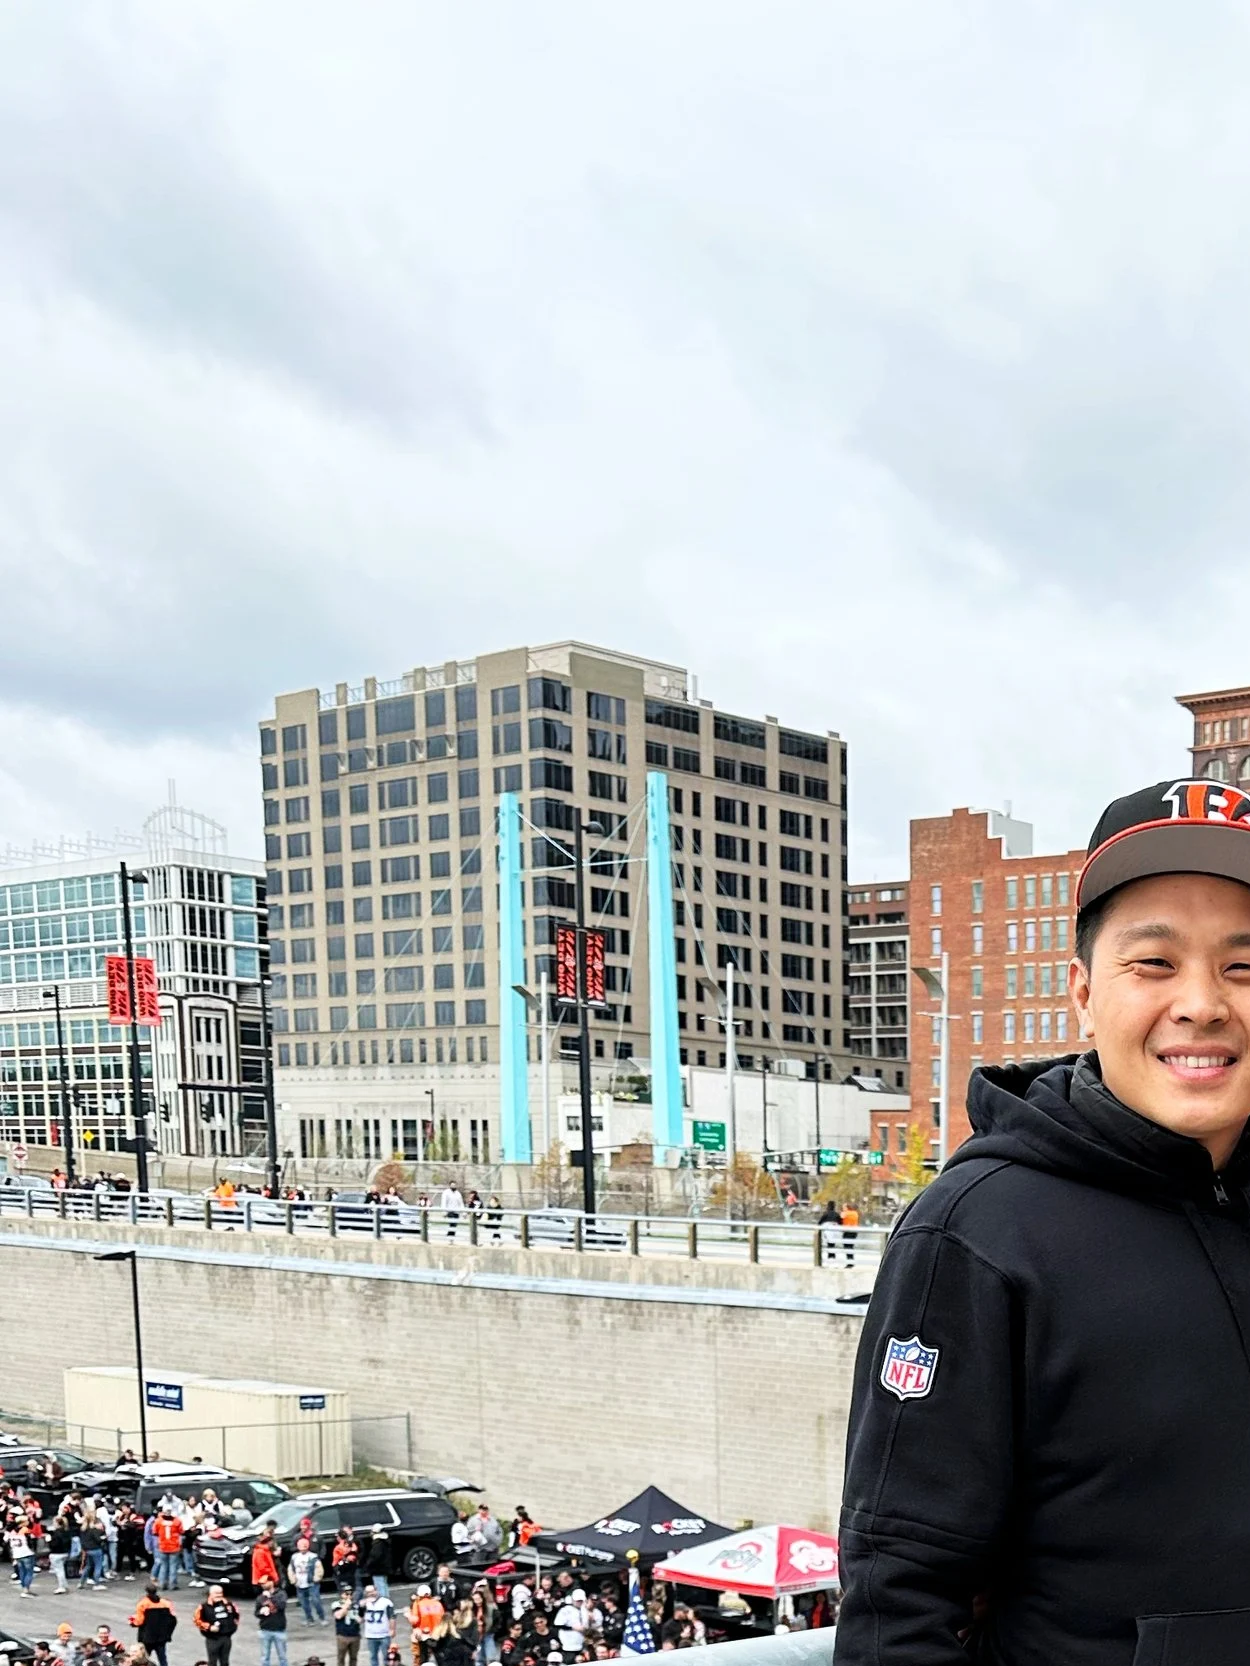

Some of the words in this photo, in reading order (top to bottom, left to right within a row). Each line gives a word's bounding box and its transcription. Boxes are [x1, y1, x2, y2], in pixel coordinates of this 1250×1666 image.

[558, 963, 566, 995] WHO
[586, 967, 595, 998] WHO
[109, 989, 118, 1015] WHO
[138, 990, 147, 1016] WHO
[888, 1360, 925, 1390] NFL
[367, 1609, 385, 1624] 37
